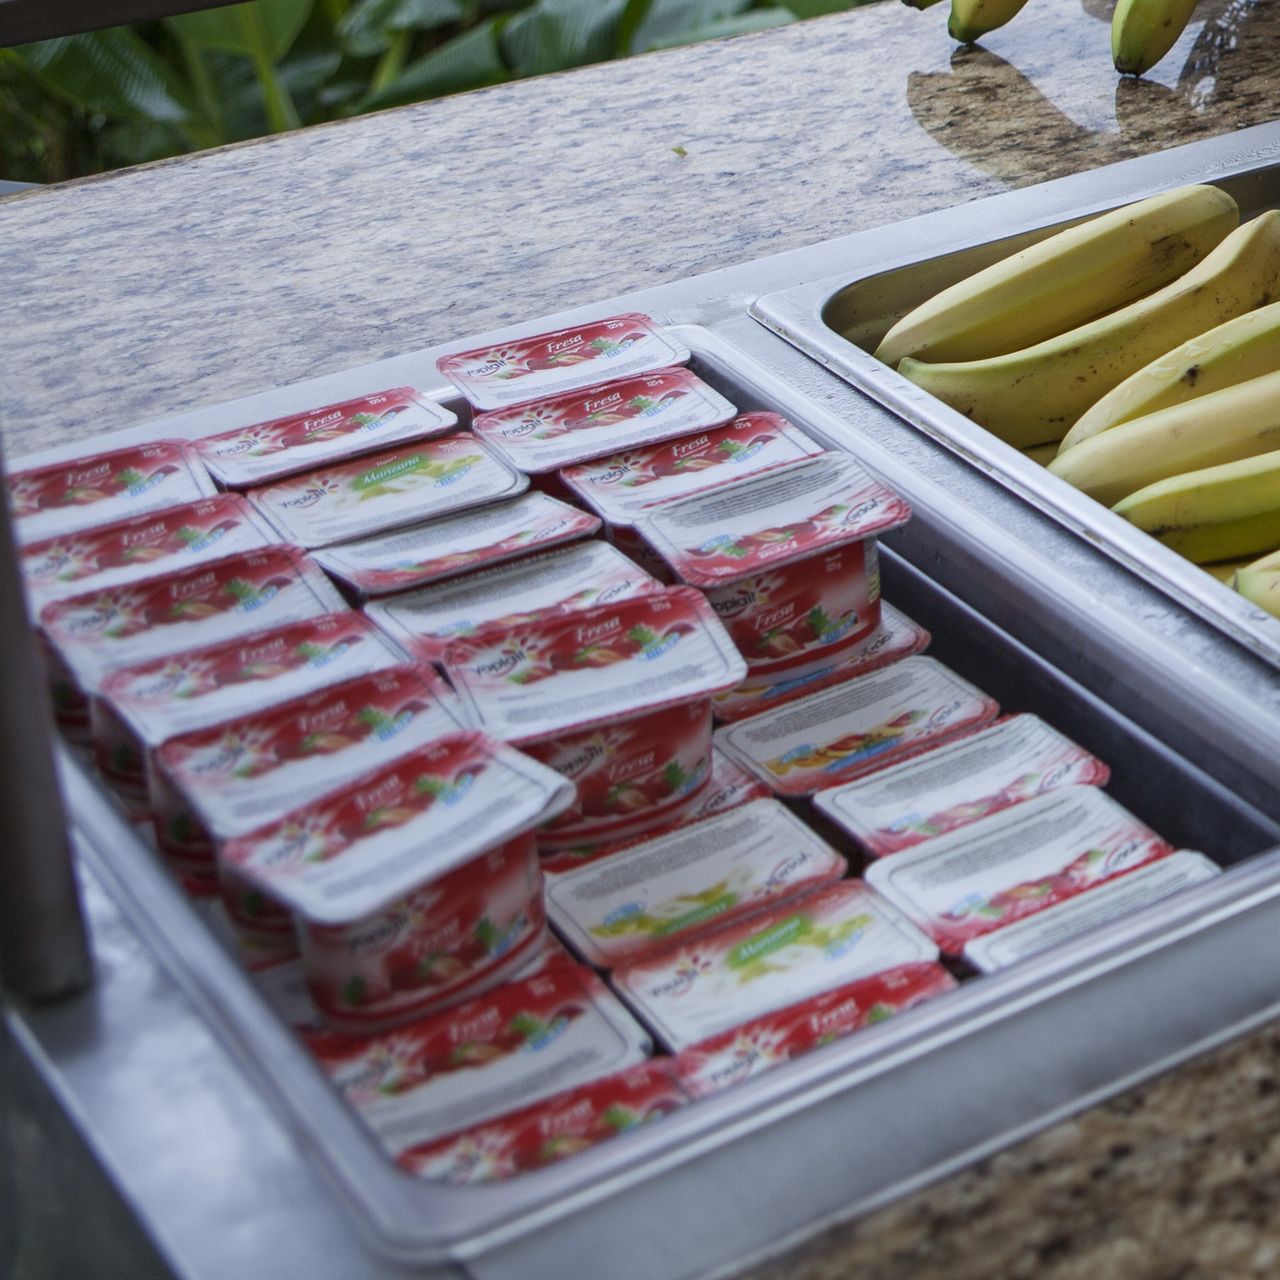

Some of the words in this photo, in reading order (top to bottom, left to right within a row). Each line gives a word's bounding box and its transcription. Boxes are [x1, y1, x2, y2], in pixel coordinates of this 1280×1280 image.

[546, 333, 582, 353] Fresa
[584, 391, 621, 412] Fresa
[303, 409, 343, 431] Fresa
[672, 434, 709, 456] Fresa
[67, 462, 111, 485] Fresa
[363, 456, 420, 485] Manzana
[122, 522, 166, 546] Fresa
[170, 571, 216, 598] Fresa
[755, 602, 797, 631] Fresa
[576, 617, 622, 643] Fresa
